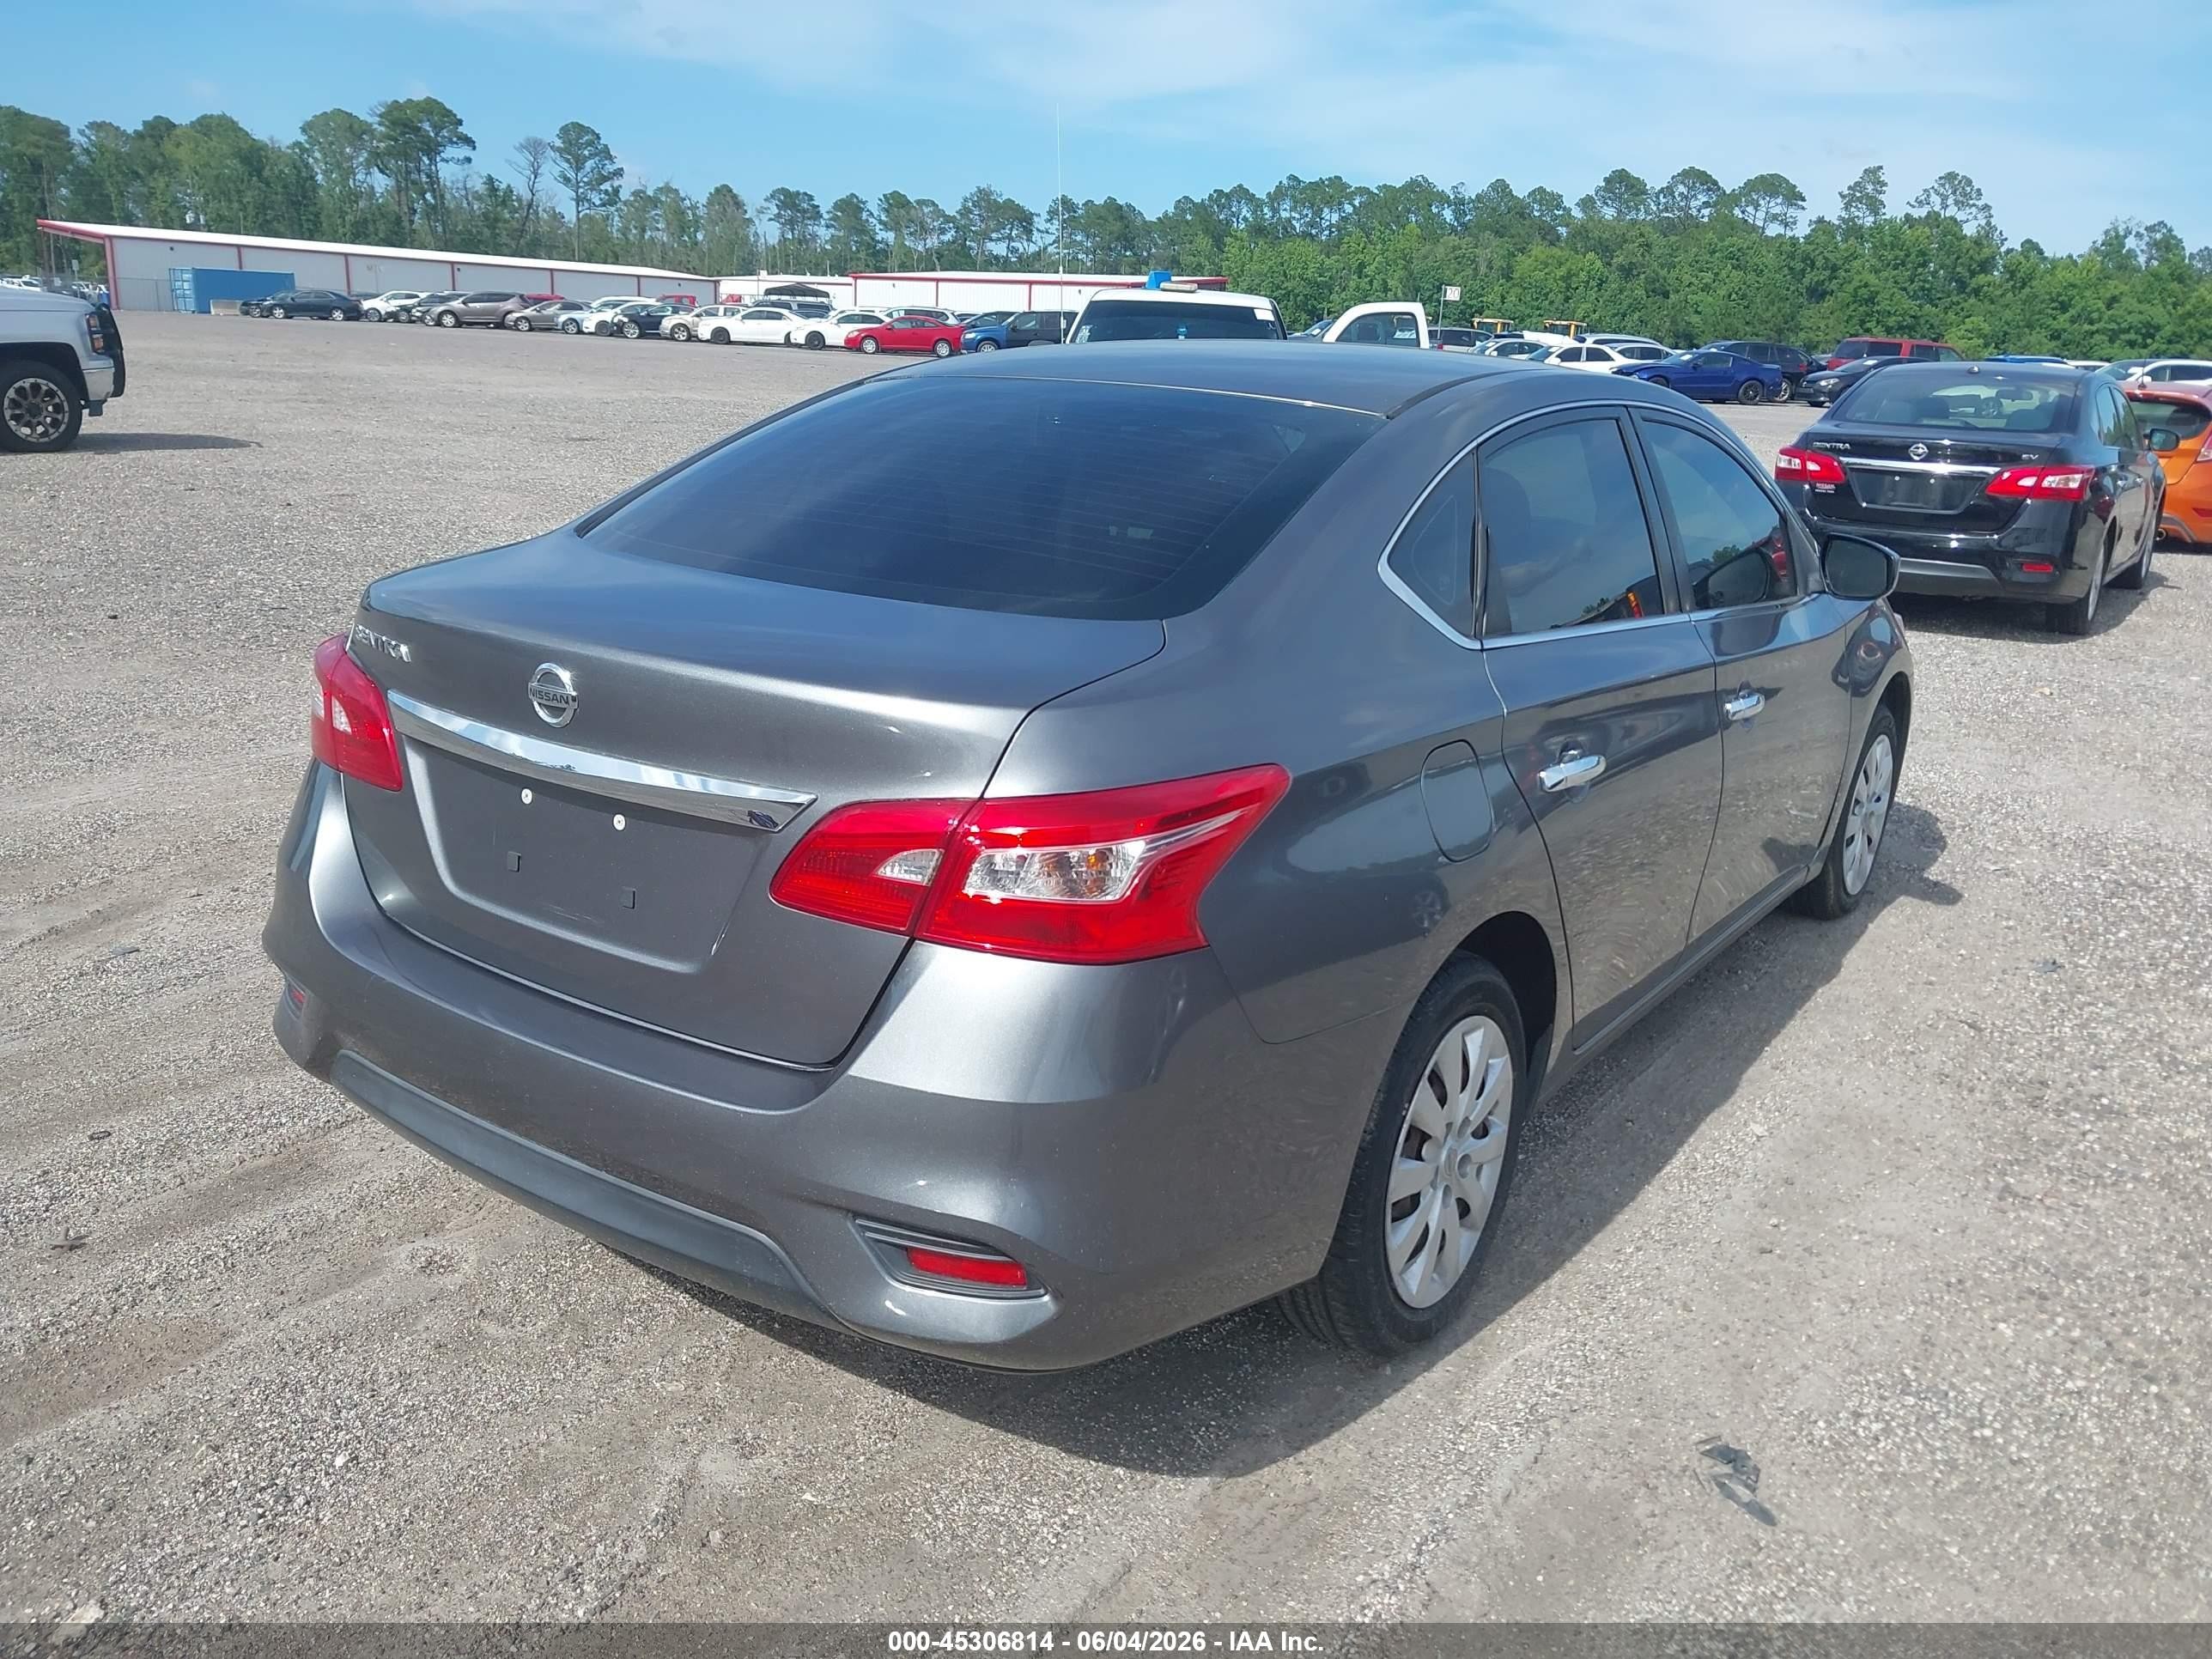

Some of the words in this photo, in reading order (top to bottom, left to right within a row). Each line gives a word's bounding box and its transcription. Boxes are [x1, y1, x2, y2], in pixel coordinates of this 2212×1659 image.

[1448, 288, 1460, 299] 20
[1813, 441, 1850, 450] SENTRA
[356, 623, 412, 662] SENTRA
[530, 686, 570, 707] NISSAN
